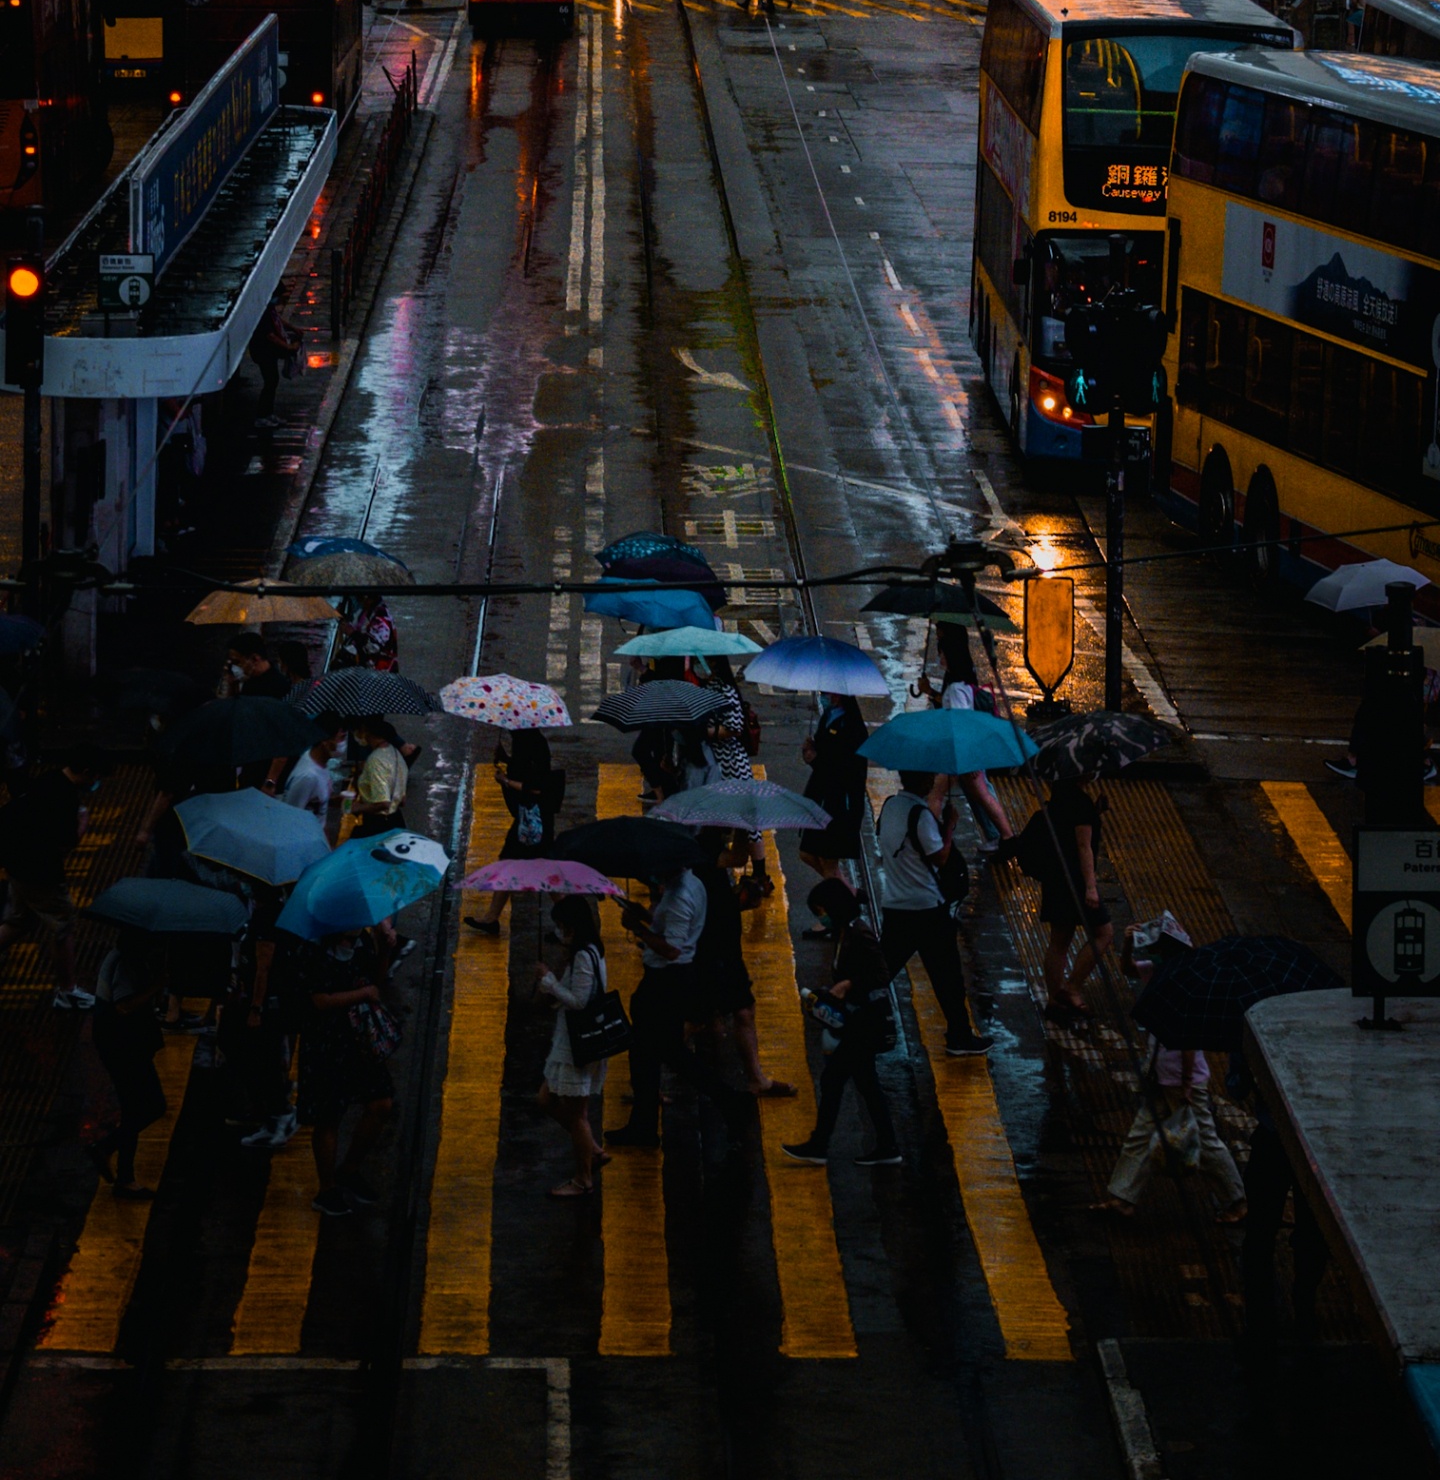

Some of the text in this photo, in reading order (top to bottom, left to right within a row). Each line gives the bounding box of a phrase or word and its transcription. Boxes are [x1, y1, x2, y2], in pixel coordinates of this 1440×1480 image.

[1102, 184, 1162, 201] Causeway
[1048, 211, 1077, 223] 8194
[1415, 840, 1440, 859] 百
